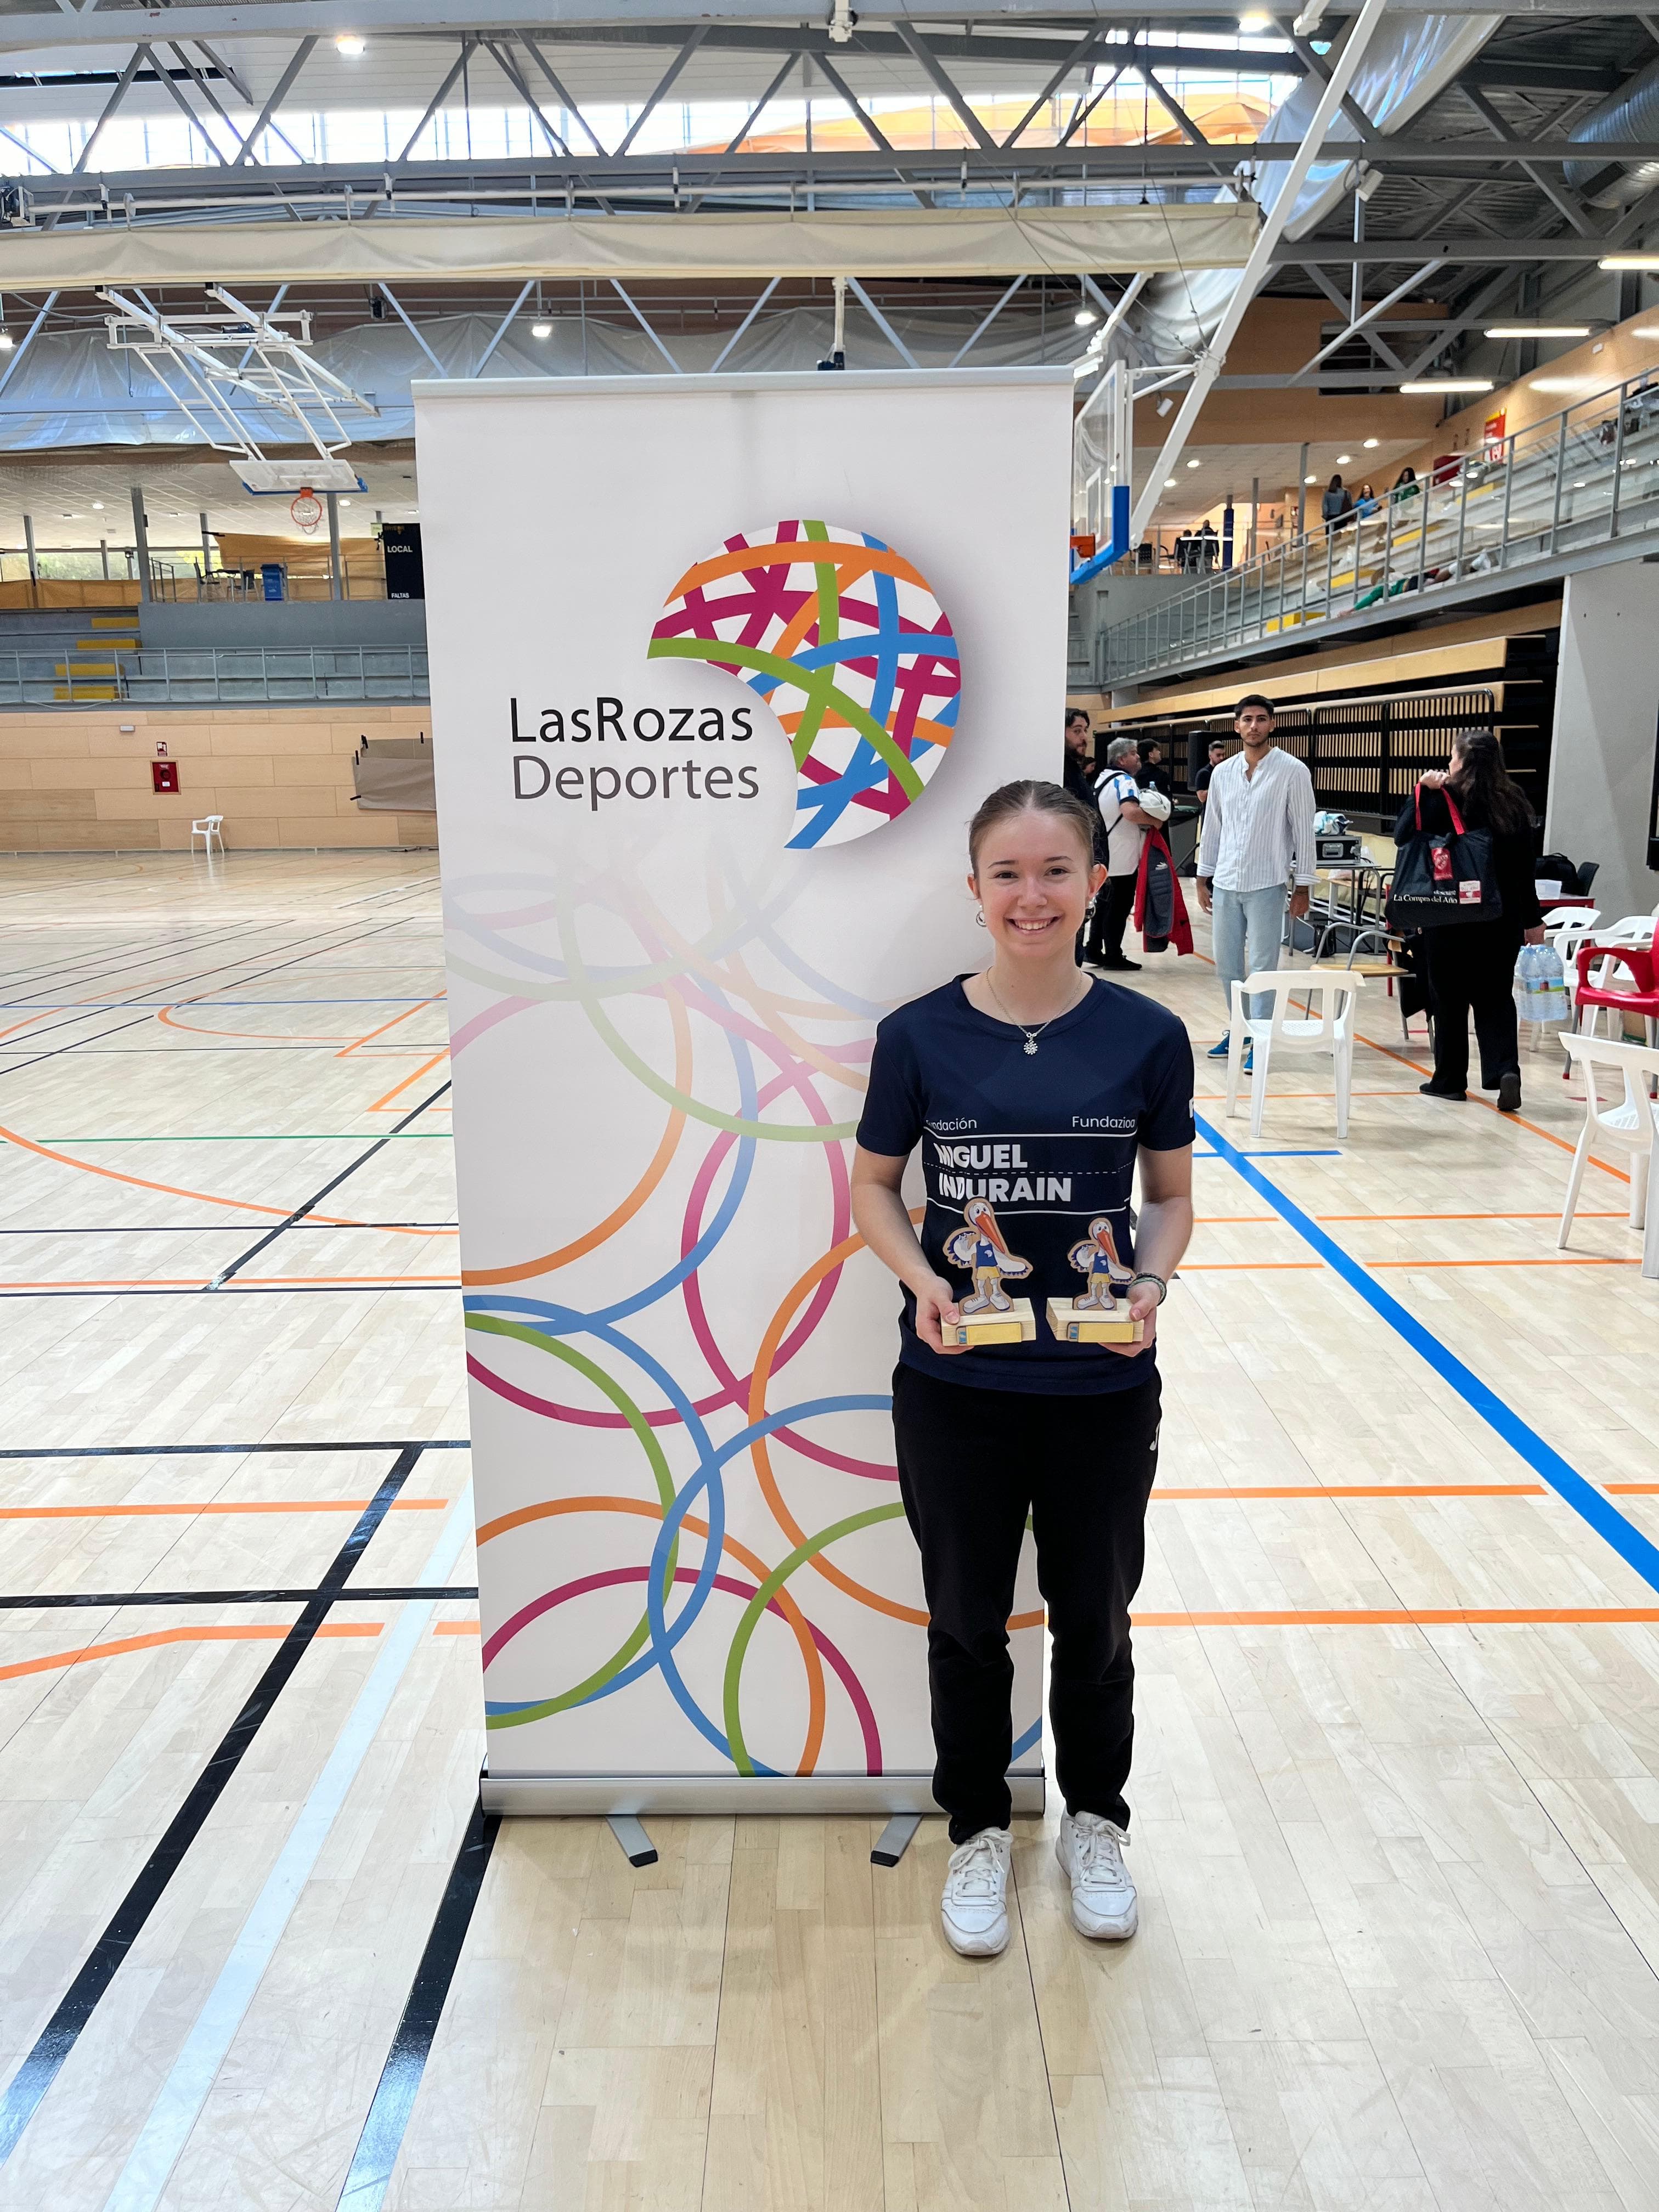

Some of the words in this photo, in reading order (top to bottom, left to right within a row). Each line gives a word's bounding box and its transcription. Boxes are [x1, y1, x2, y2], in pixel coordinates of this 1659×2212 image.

[510, 697, 753, 742] LasRozas
[513, 755, 759, 811] Deportes
[1403, 894, 1430, 904] Compra
[1072, 1115, 1136, 1128] Fundazioa
[933, 1142, 1028, 1170] MIGUEL
[939, 1172, 1071, 1203] INDURAIN
